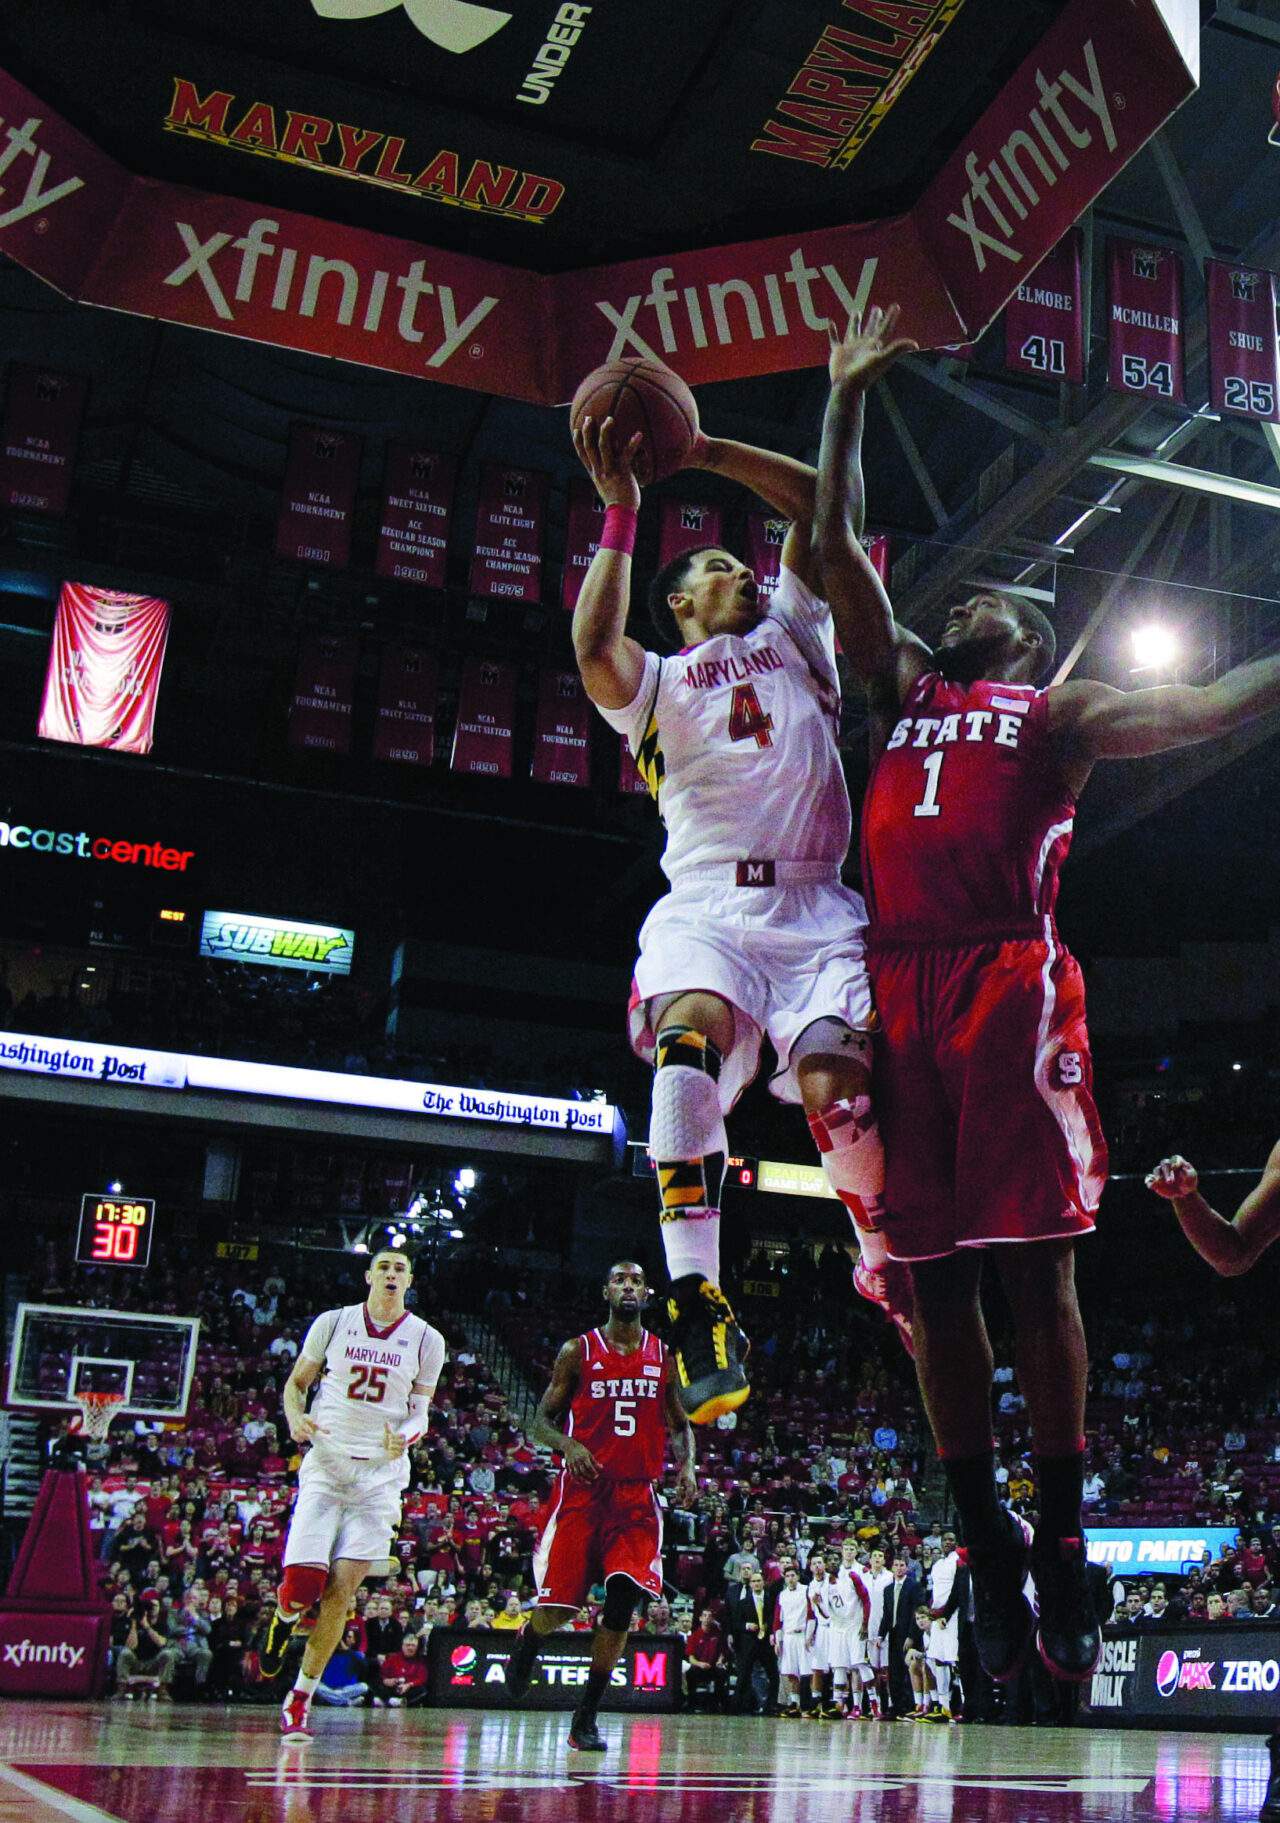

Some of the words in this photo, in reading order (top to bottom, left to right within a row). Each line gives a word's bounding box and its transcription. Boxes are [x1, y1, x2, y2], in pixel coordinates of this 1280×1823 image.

[516, 2, 593, 105] UNDER
[750, 0, 941, 168] MARYLA
[168, 77, 566, 217] MARYLAND
[946, 38, 1120, 272] xfinity
[163, 218, 499, 369] xfinity
[595, 247, 879, 362] xfinity
[1017, 285, 1073, 312] ELMORE
[1112, 304, 1179, 336] MCMILLEN
[1020, 335, 1066, 374] 41
[1228, 330, 1264, 353] SHUE
[1121, 354, 1174, 397] 54
[1223, 376, 1275, 415] 25
[289, 501, 346, 521] TOURNAMENT
[308, 491, 331, 505] NCAA
[502, 504, 524, 516] NCAA
[489, 513, 512, 526] ELITE
[512, 516, 536, 529] EIGHT
[381, 526, 417, 543] REGULAR
[417, 533, 447, 549] SEASON
[389, 541, 435, 558] CHAMPIONS
[475, 545, 512, 560] REGULAR
[513, 550, 542, 564] SEASON
[485, 559, 531, 575] CHAMPIONS
[490, 581, 524, 597] 1975
[682, 648, 784, 691] MARYLAND
[294, 695, 353, 715] TOURNAMENT
[728, 683, 775, 750] 4
[541, 734, 587, 748] TOURNAMENT
[886, 709, 1022, 750] STATE
[913, 751, 945, 817] 1
[207, 922, 348, 964] SUBWAY
[102, 1055, 147, 1081] Post
[422, 1090, 454, 1114] The
[459, 1092, 560, 1125] Washington
[565, 1107, 605, 1130] Post
[740, 1169, 754, 1187] 0
[95, 1202, 147, 1227] 17:30
[91, 1222, 139, 1261] 30
[344, 1346, 402, 1368] MARYLAND
[346, 1365, 389, 1403] 25
[591, 1379, 659, 1399] STATE
[614, 1400, 637, 1437] 5
[1137, 1540, 1207, 1563] PARTS
[3, 1639, 86, 1669] xfinity
[632, 1651, 668, 1688] M
[1178, 1661, 1212, 1690] MAX
[1220, 1659, 1280, 1692] ZERO
